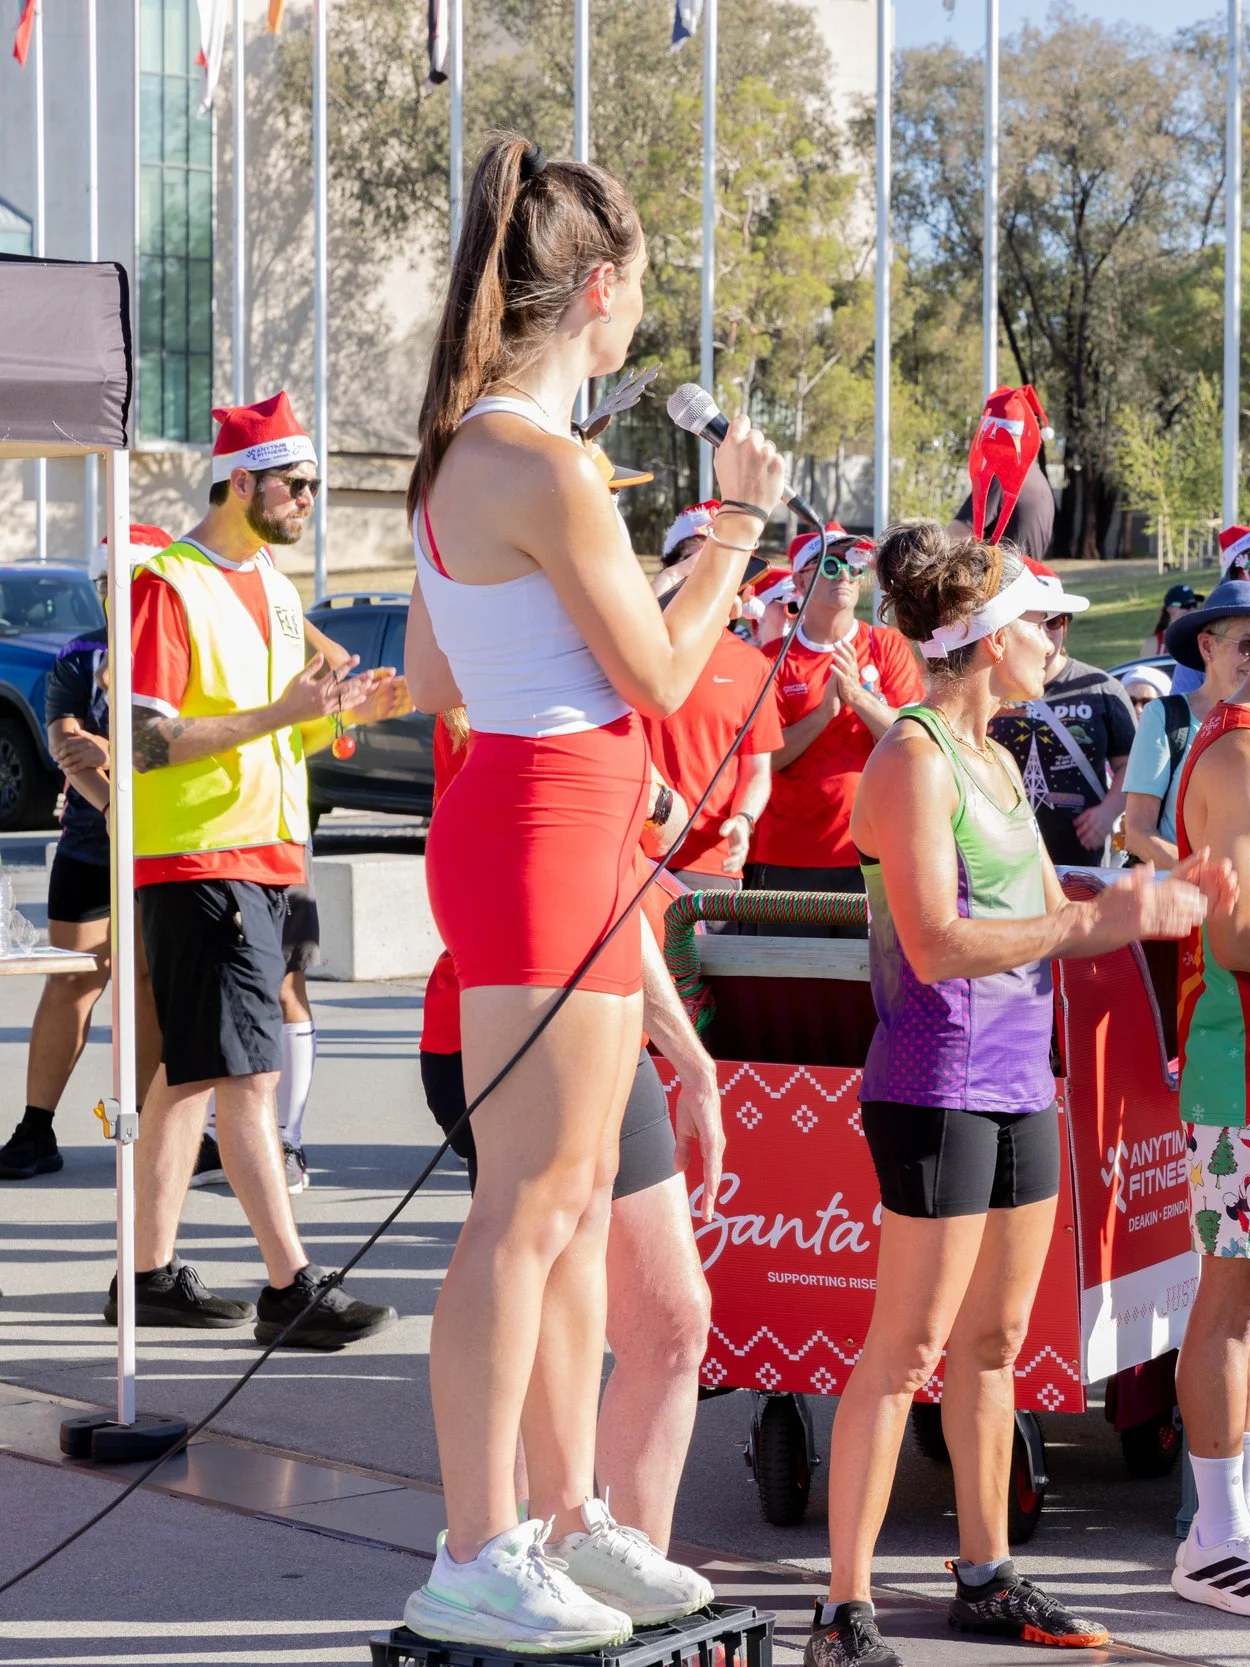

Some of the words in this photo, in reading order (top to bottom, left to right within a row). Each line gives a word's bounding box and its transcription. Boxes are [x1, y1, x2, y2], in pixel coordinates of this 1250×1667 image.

[1026, 703, 1093, 720] RDIO
[1128, 1209, 1158, 1233] DEAKIN
[767, 1271, 847, 1288] SUPPORTING
[849, 1277, 877, 1290] RISE
[1161, 1276, 1199, 1316] JUST
